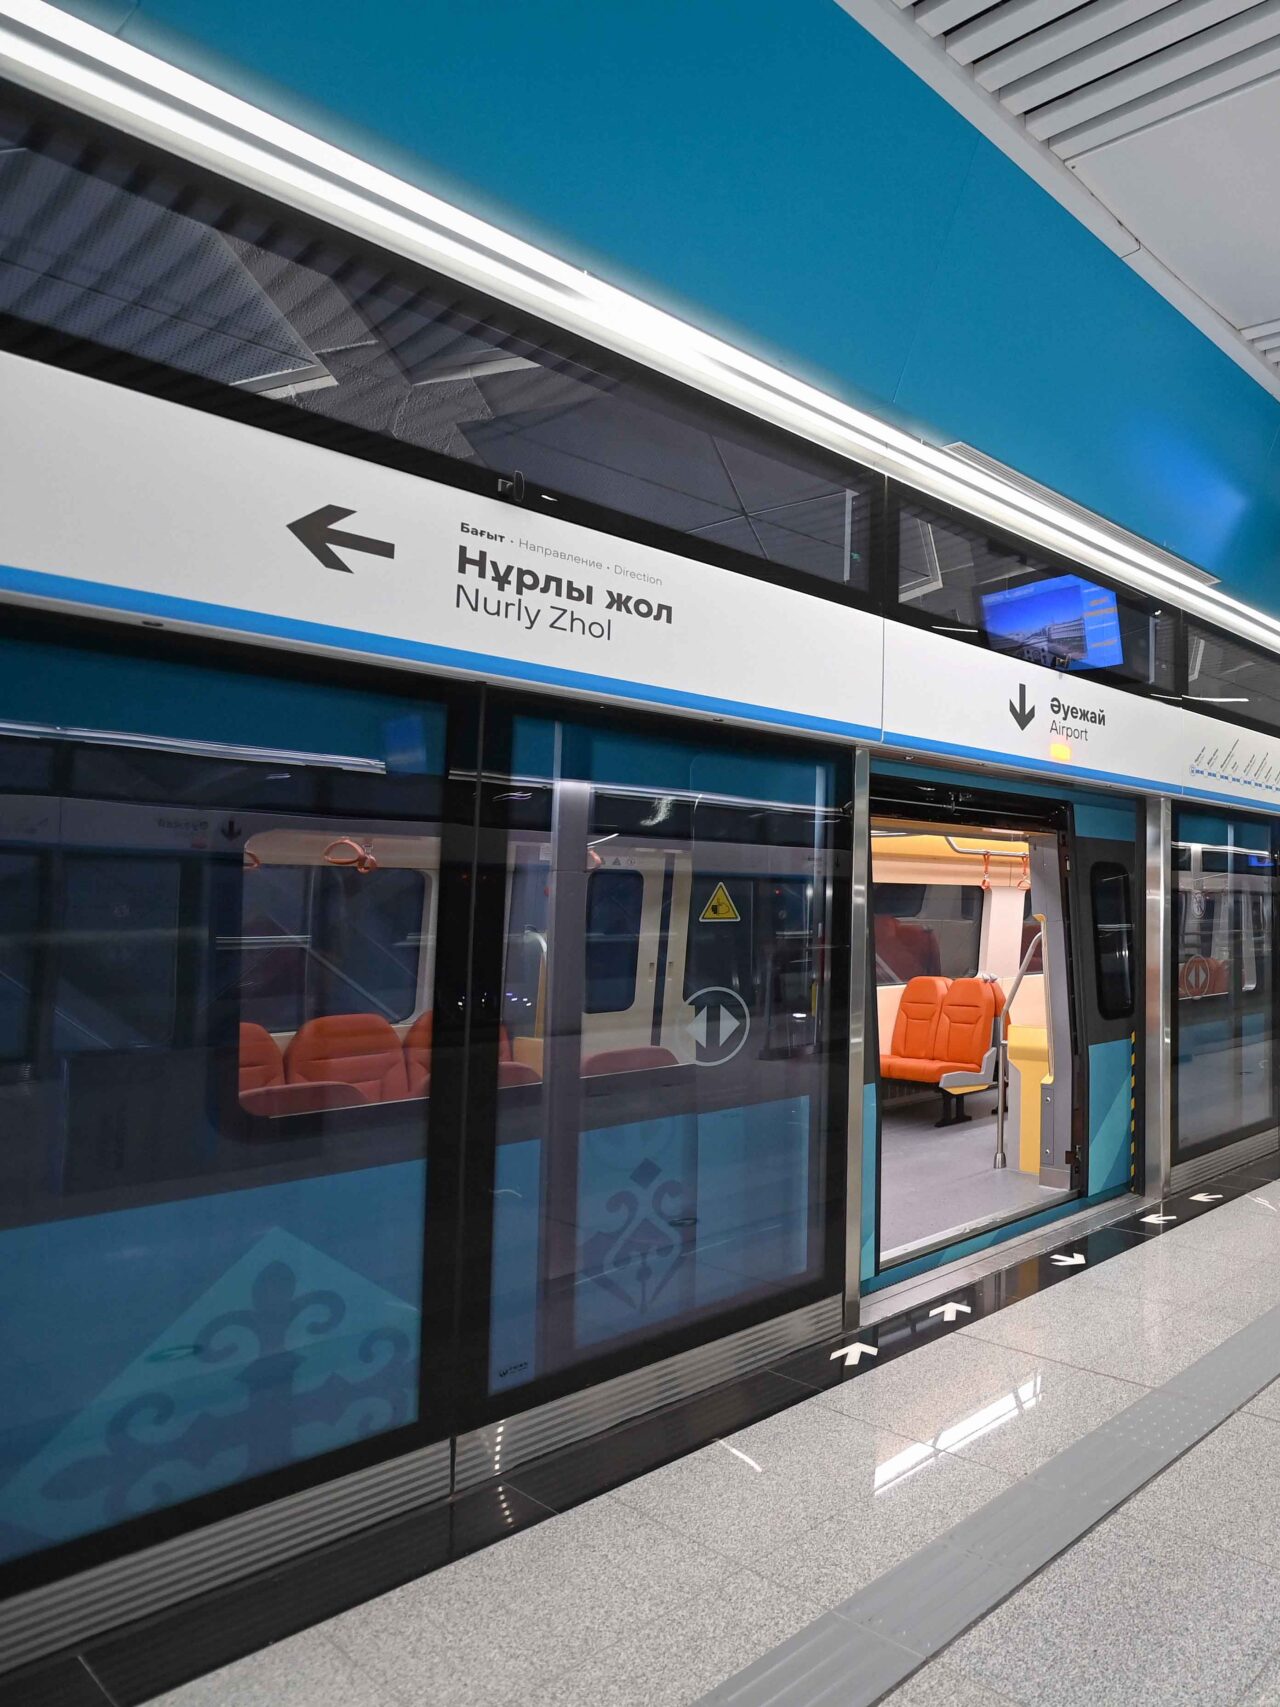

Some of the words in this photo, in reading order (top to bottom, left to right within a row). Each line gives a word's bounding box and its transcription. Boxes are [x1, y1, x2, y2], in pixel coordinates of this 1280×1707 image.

[460, 522, 506, 543] Бағыт
[518, 538, 603, 570] Направление
[457, 544, 594, 605] Нұрлы
[604, 589, 673, 624] жол
[613, 564, 663, 586] Direction
[455, 583, 541, 630] Nurly
[548, 605, 612, 641] Zhol
[1049, 719, 1089, 742] Airport
[1050, 697, 1106, 726] Әуежай
